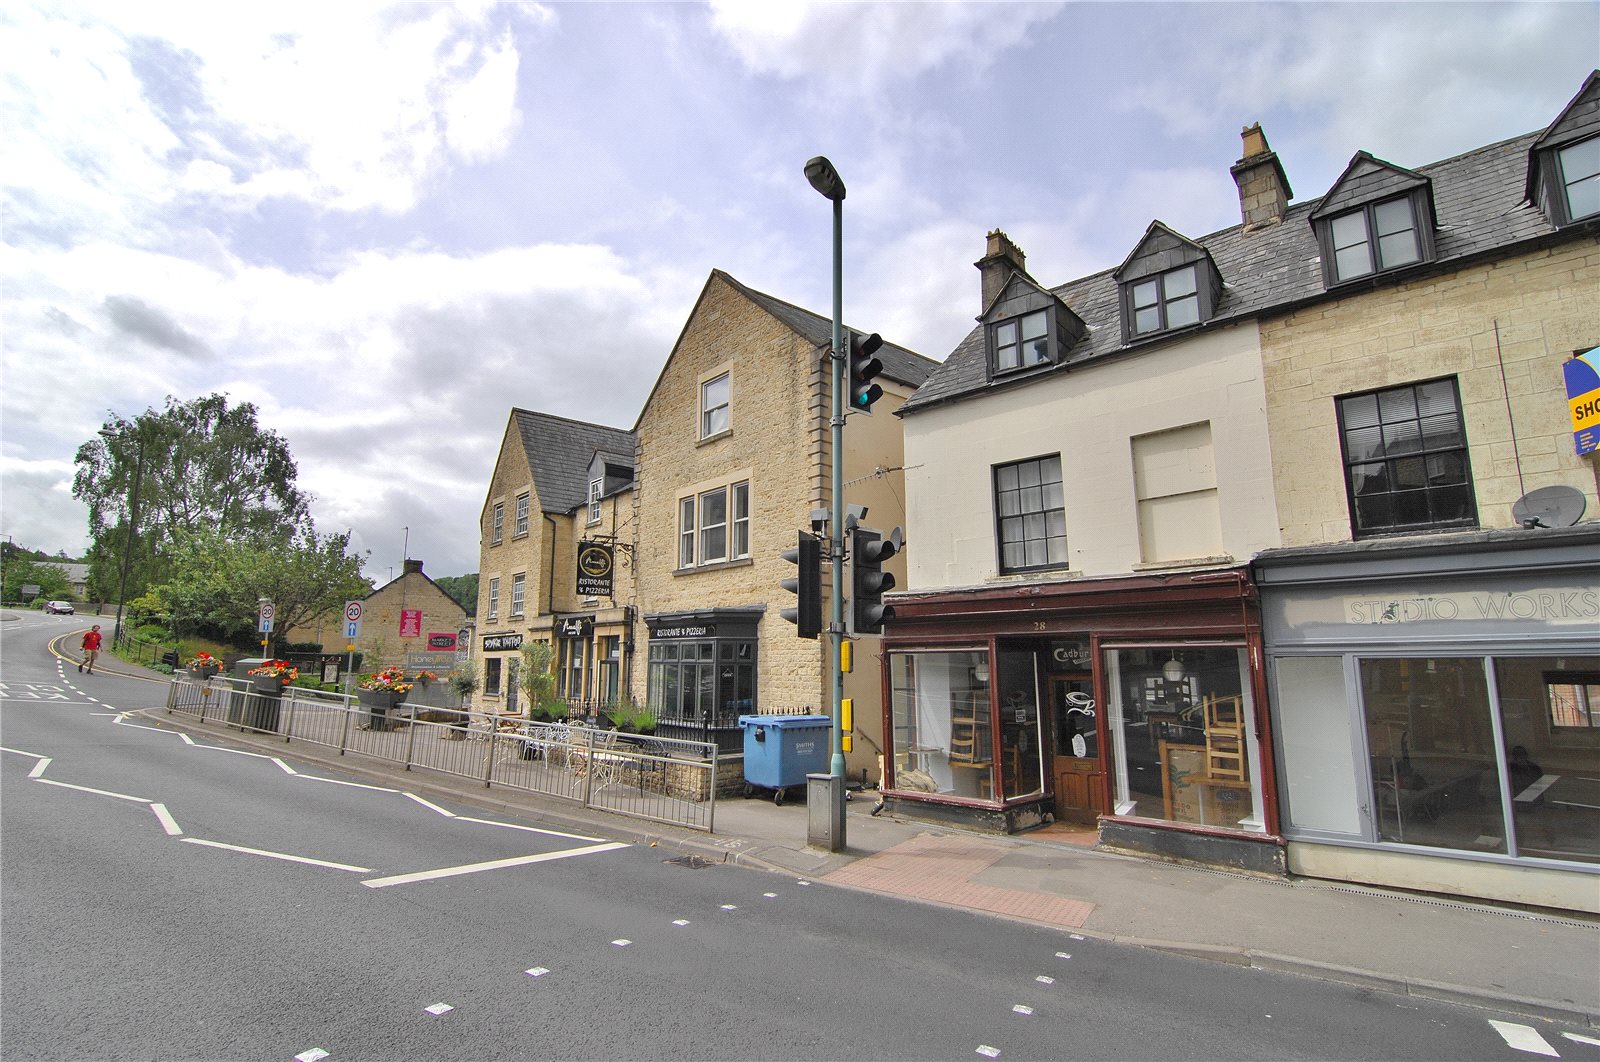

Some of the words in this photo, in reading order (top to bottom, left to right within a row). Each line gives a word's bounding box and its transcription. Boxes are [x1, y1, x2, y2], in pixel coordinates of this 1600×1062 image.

[578, 578, 611, 586] RISTORANTE
[585, 586, 610, 594] PIZZERIA
[348, 608, 359, 616] 20
[1350, 597, 1459, 624] STUDIO
[1472, 591, 1600, 621] WORKS
[1034, 621, 1046, 631] 28
[657, 627, 680, 637] RISTORANTE
[686, 626, 706, 636] PIZZERIA
